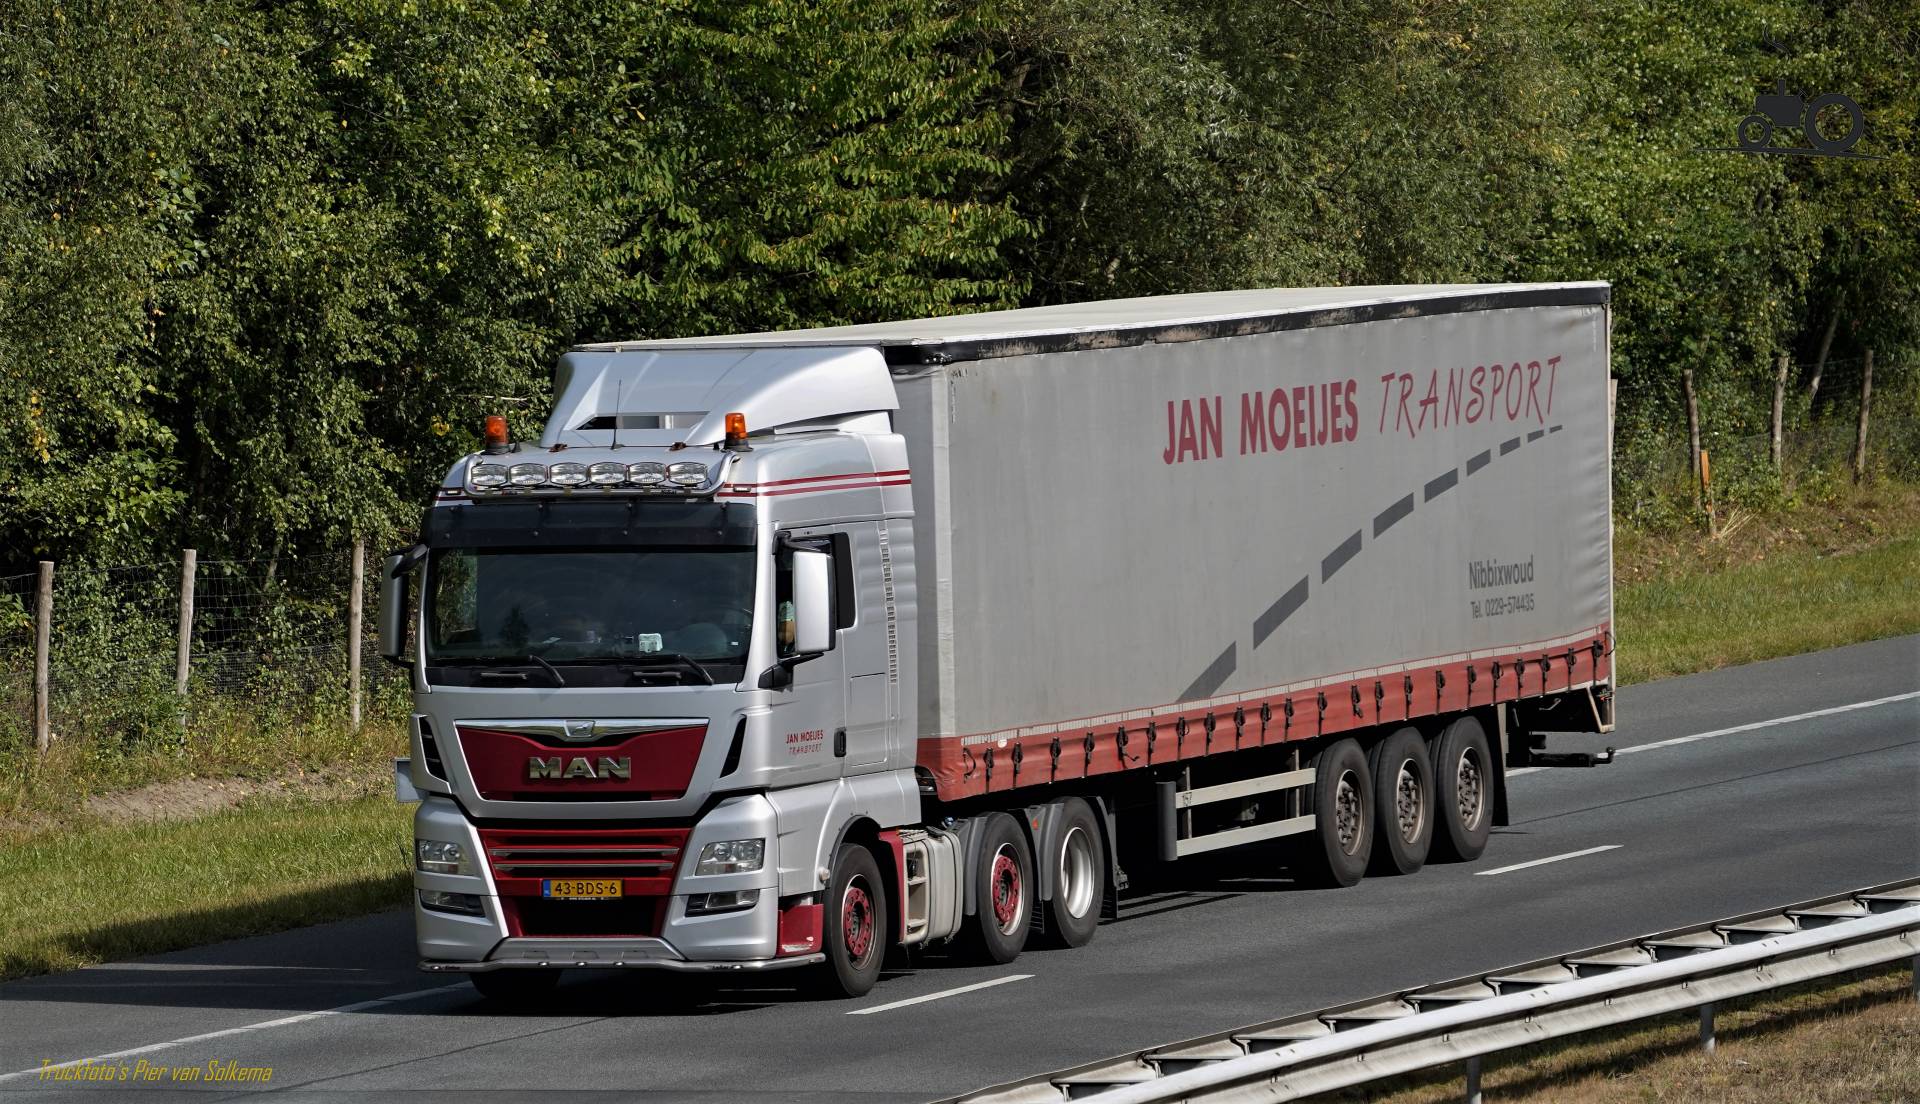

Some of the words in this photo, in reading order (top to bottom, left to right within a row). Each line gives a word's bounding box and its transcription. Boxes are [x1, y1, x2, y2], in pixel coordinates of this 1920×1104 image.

[1163, 396, 1223, 465] JAN
[1240, 379, 1359, 455] MOEIJES
[1379, 355, 1561, 439] TRANSPORT
[1468, 554, 1534, 590] Nibbixwoud
[786, 733, 799, 744] JAN
[800, 730, 824, 743] MOEIJES
[789, 743, 822, 754] TRANSPORT
[528, 757, 631, 779] MAN
[555, 882, 617, 895] 43-BDS-6
